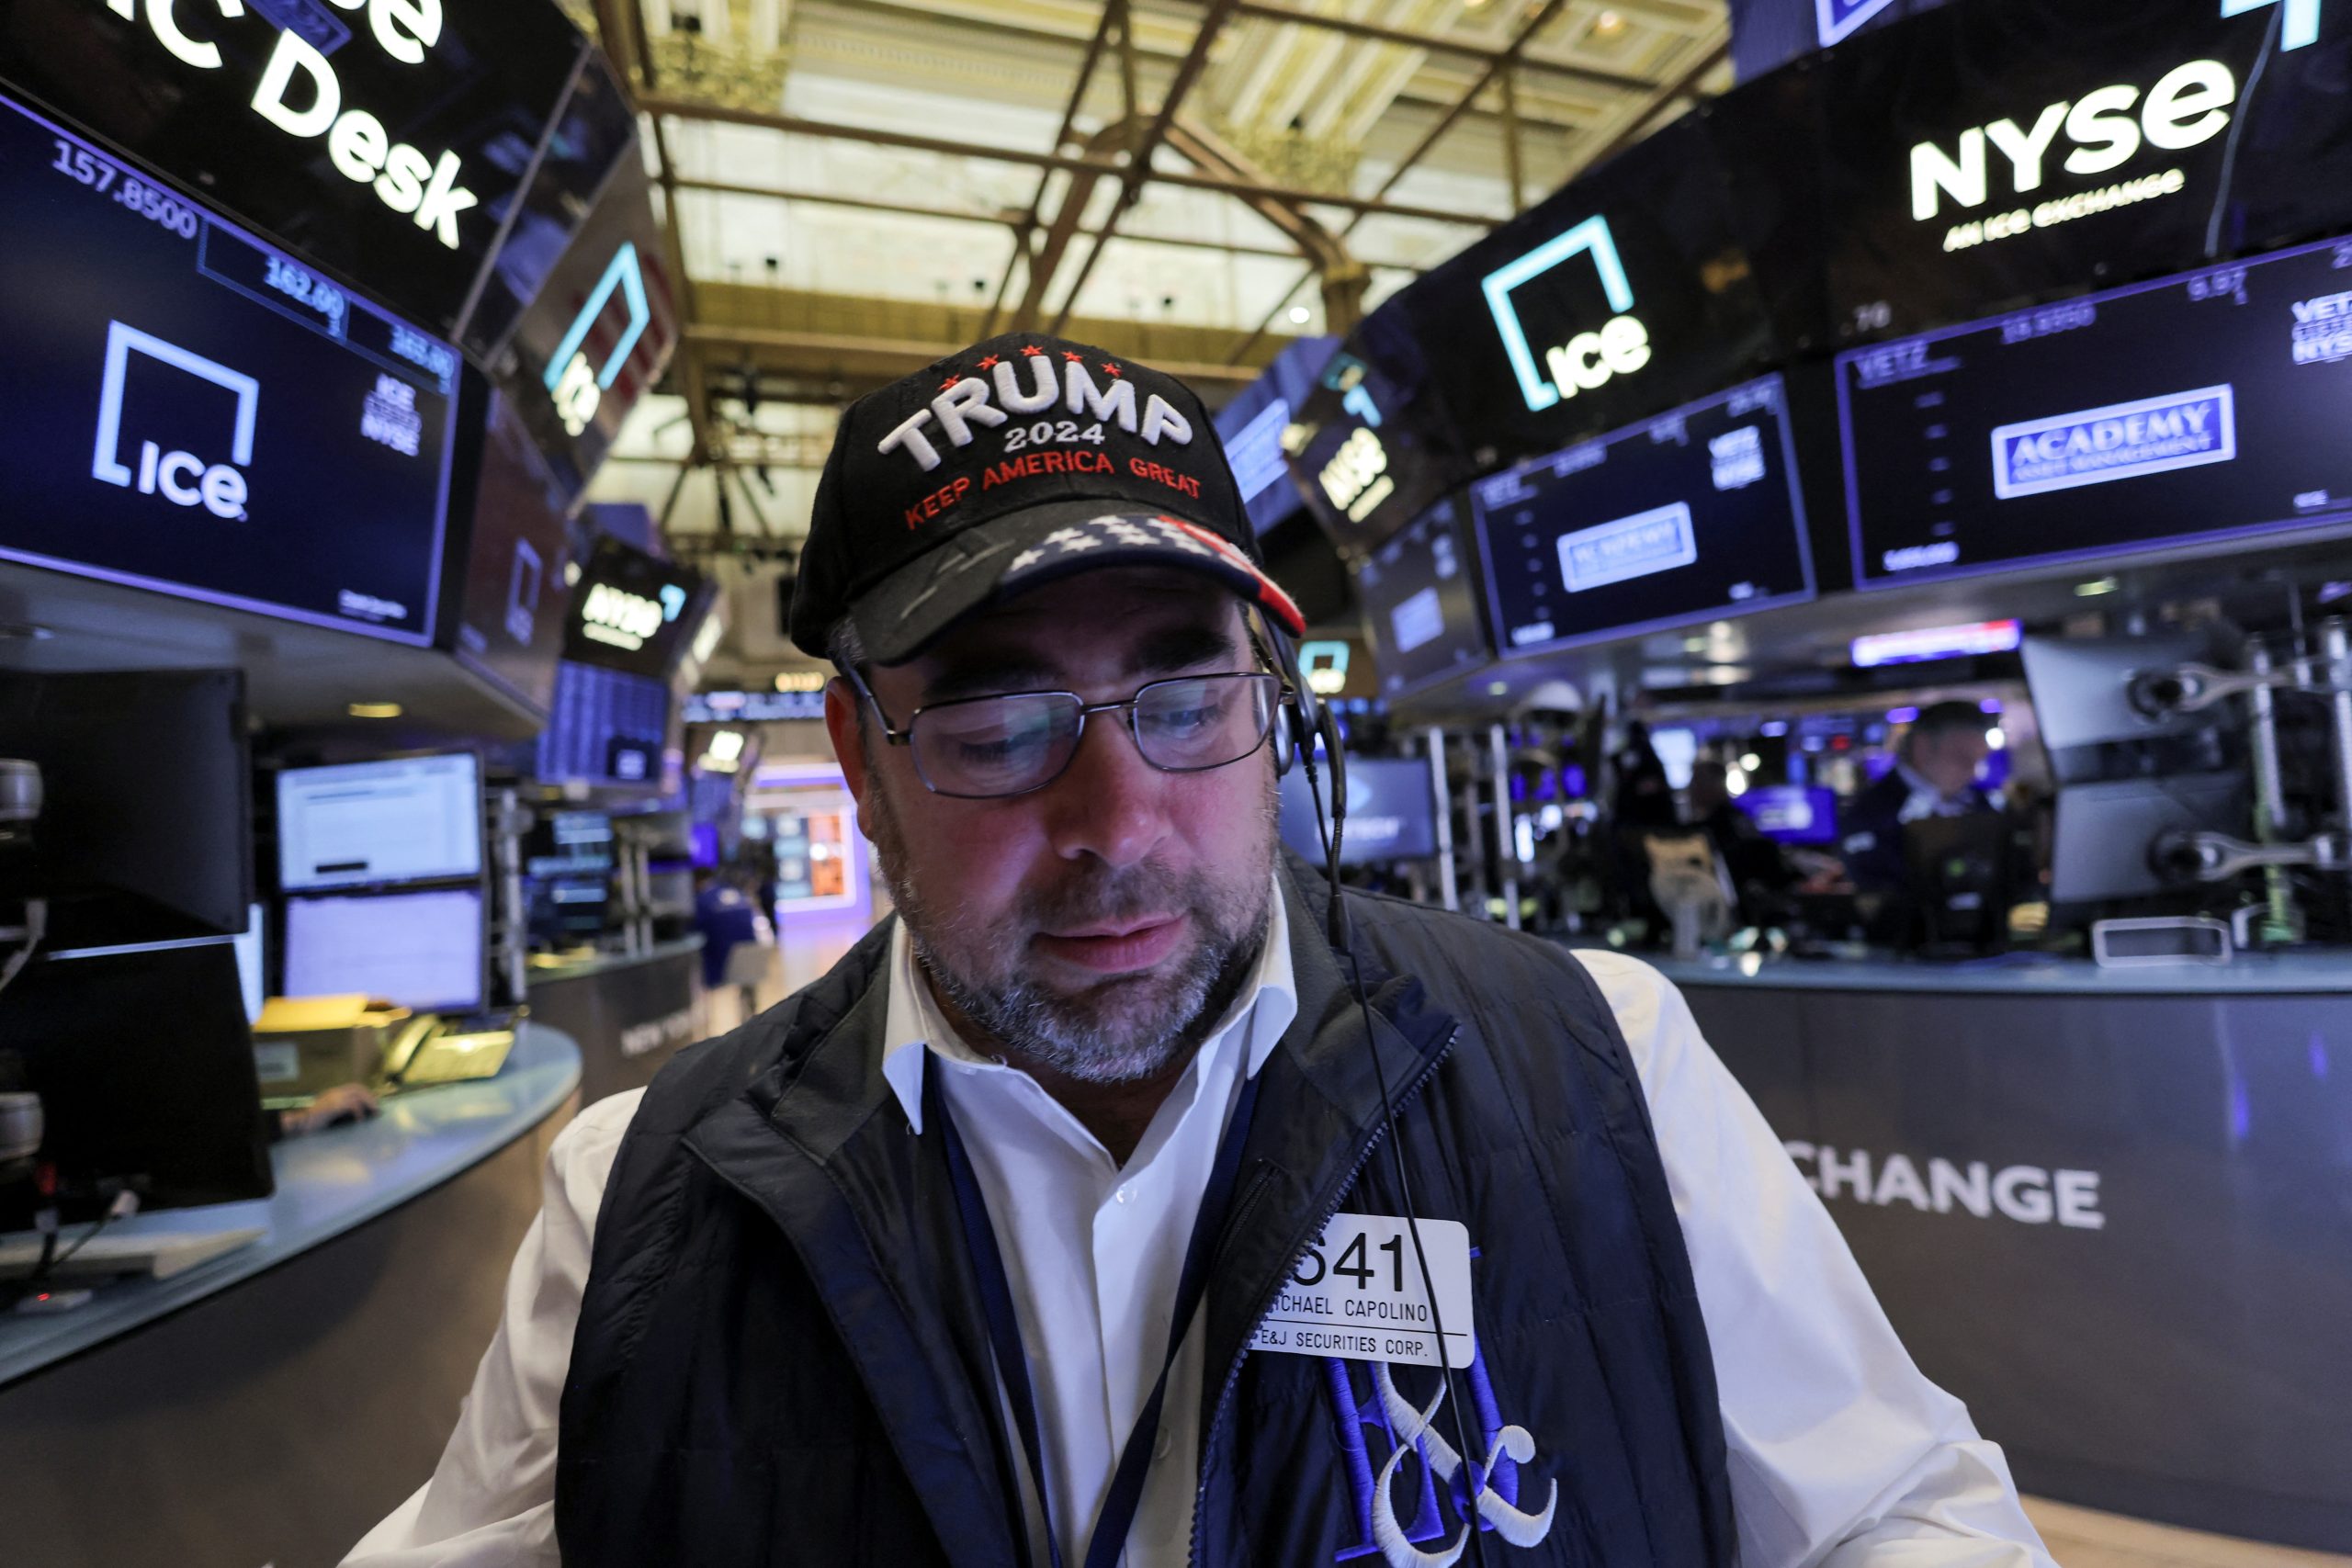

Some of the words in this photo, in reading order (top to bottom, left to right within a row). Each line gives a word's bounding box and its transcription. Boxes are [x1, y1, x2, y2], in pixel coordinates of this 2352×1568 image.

[251, 28, 479, 250] Desk
[2291, 290, 2352, 323] VET
[2292, 331, 2352, 366] NYS
[877, 355, 1193, 472] TRUMP
[1003, 421, 1105, 453] 2024
[2011, 400, 2213, 467] ACADEMY
[904, 476, 971, 531] KEEP
[980, 449, 1115, 491] AMERICA
[1129, 457, 1201, 500] GREAT
[1273, 1293, 1334, 1315] ICHAEL
[1345, 1299, 1428, 1322] CAPOLINO
[1295, 1332, 1376, 1353] SECURITIES
[1385, 1339, 1428, 1357] CORP.
